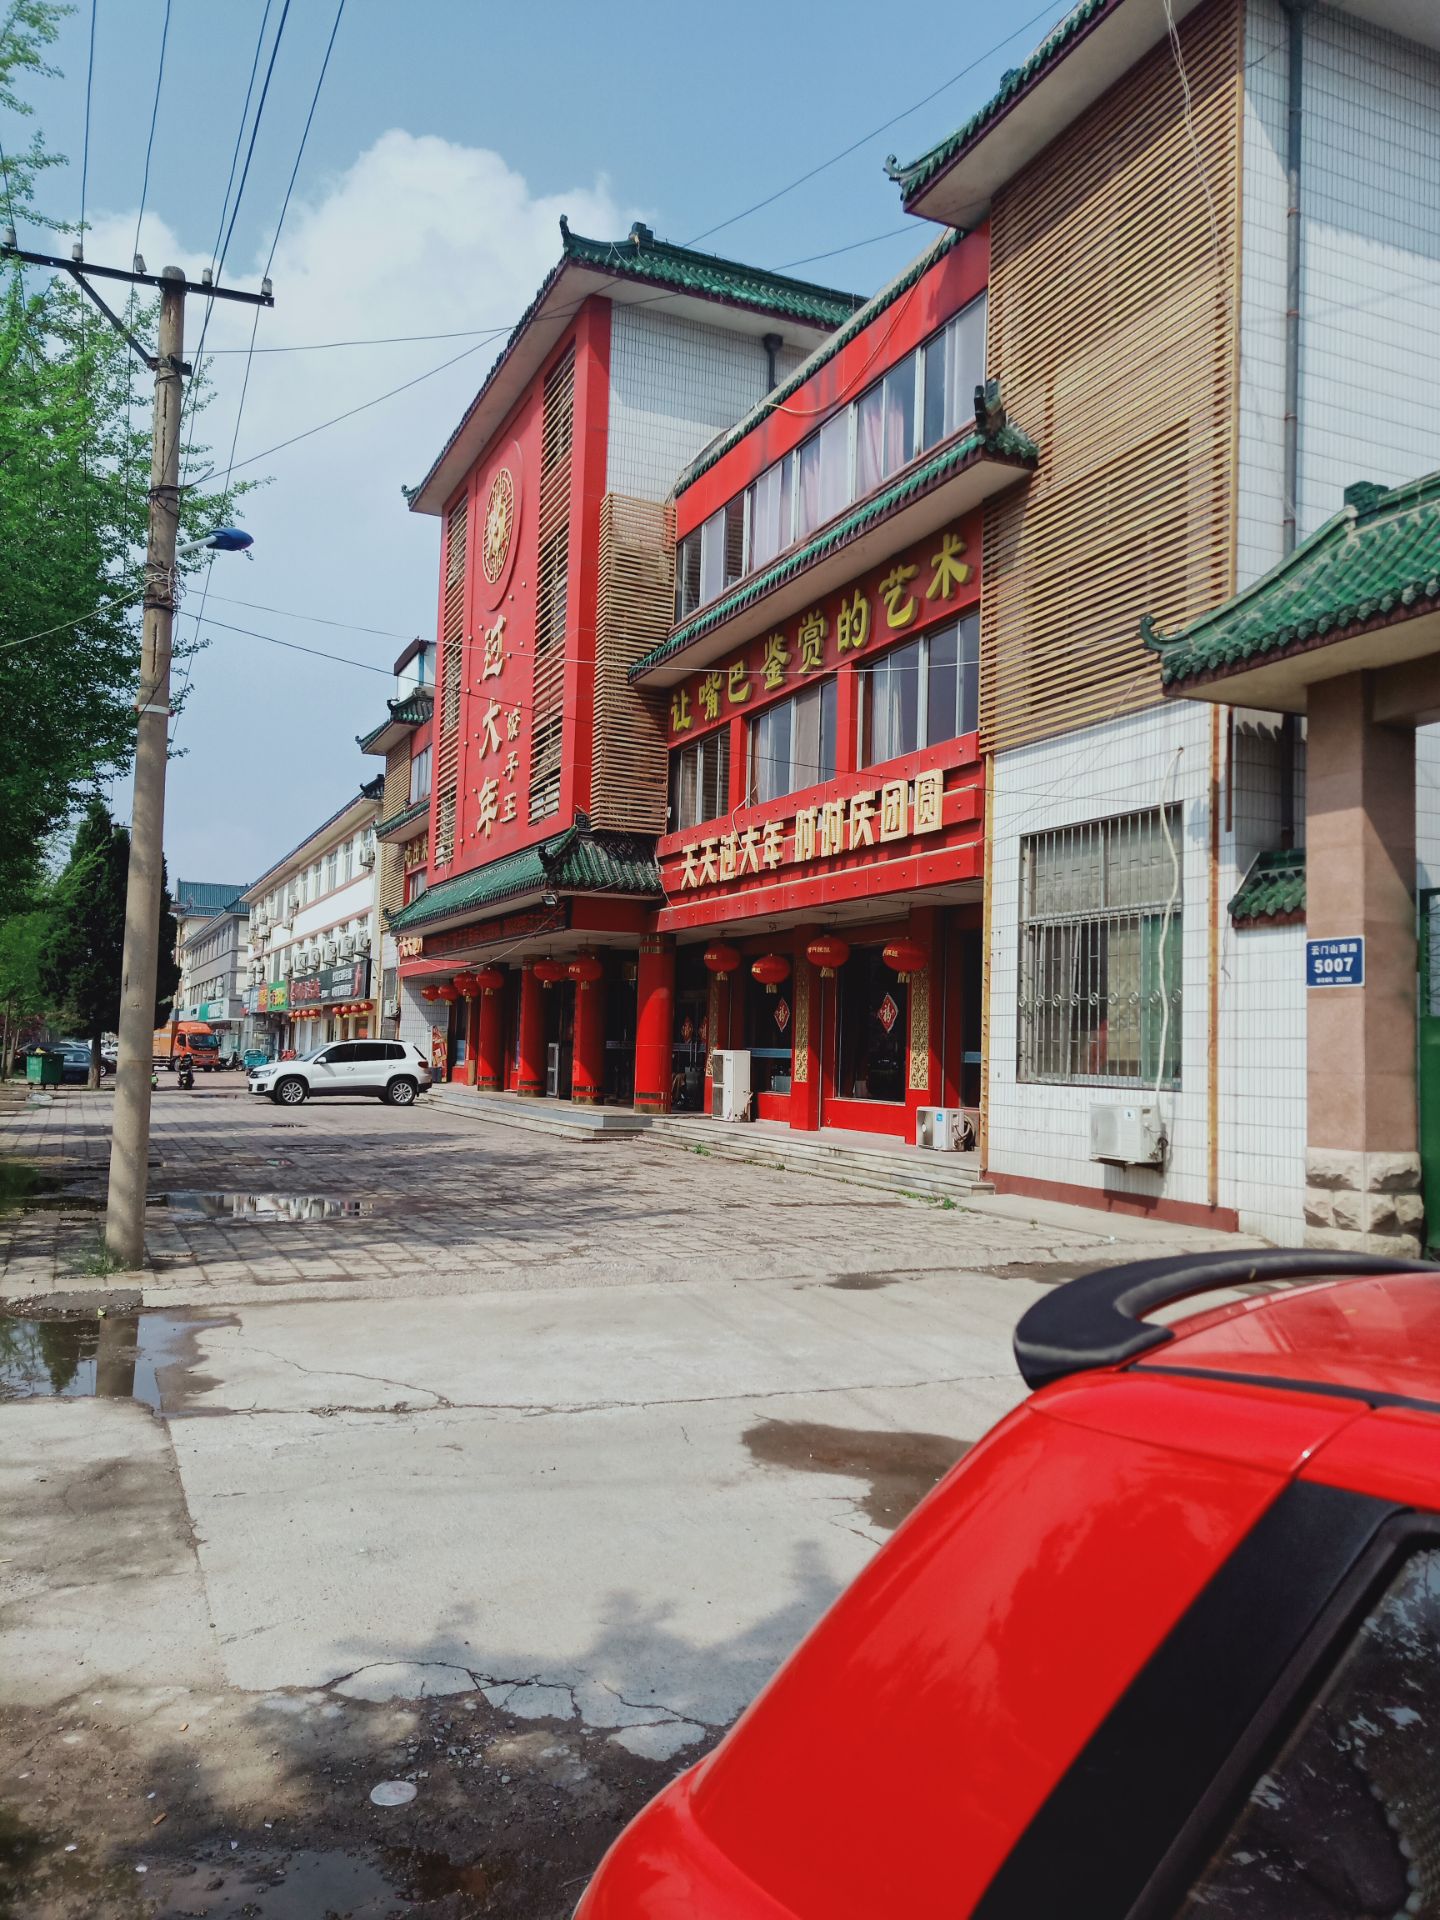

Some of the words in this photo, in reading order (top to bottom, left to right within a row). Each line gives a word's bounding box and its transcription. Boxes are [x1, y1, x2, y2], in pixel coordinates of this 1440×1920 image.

[671, 533, 971, 732] 让嘴巴鉴赏的艺术
[500, 708, 520, 824] 饺子王
[680, 819, 784, 892] 天天过大年
[793, 768, 944, 863] 时时庆团圆
[1314, 957, 1354, 974] 5007
